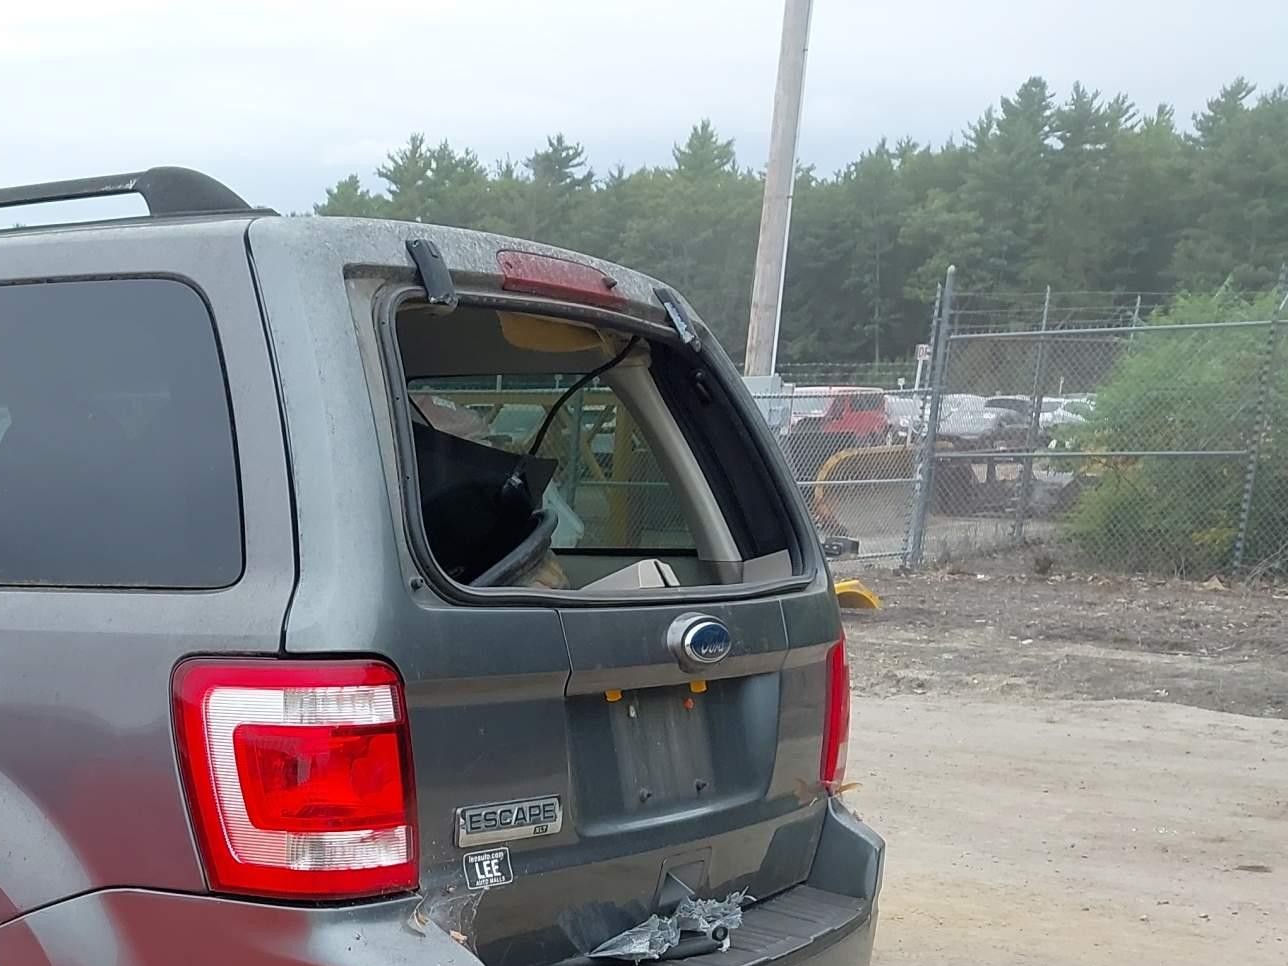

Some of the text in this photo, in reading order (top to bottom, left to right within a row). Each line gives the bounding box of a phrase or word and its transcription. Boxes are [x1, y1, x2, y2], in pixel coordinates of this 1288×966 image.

[468, 802, 556, 832] ESCAPE
[474, 860, 502, 880] LEE
[475, 878, 489, 886] AUTO
